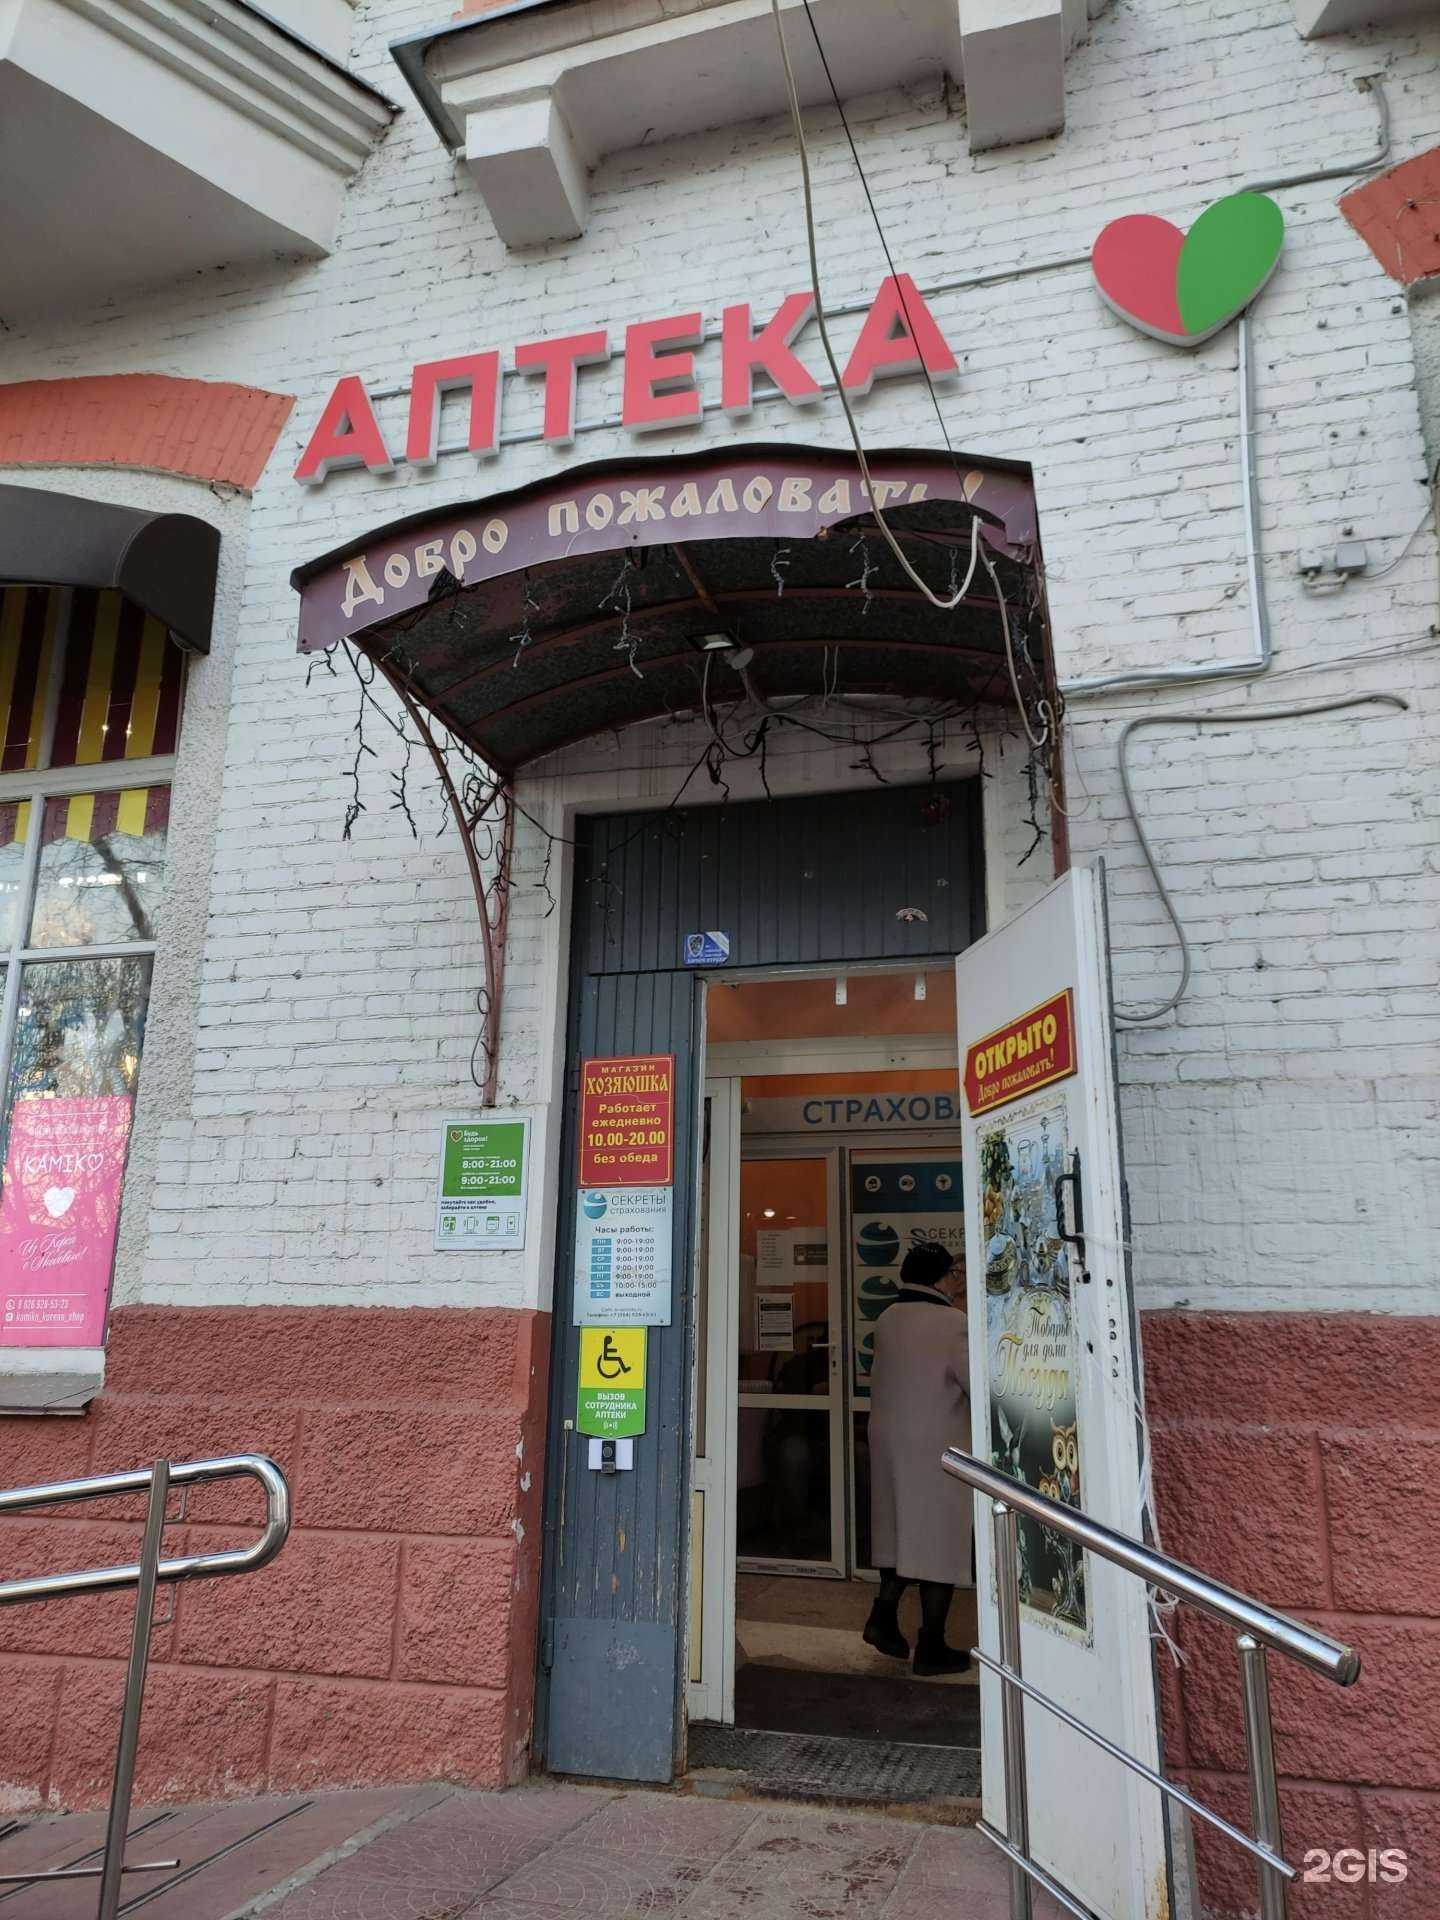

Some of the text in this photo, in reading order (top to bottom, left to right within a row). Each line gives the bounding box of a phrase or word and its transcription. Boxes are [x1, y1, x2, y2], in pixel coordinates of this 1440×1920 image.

[293, 272, 960, 487] АПТЕКА
[975, 1013, 1057, 1080] ОТКРЫТО
[601, 1064, 655, 1073] МАГАЗИН
[586, 1073, 669, 1096] ХОЗЯЮШКА
[599, 1103, 656, 1114] Работает
[802, 1096, 961, 1125] СТРАХОВ
[592, 1117, 661, 1127] ежедневно
[587, 1131, 665, 1147] 10.00-20.00
[593, 1152, 657, 1163] без обеда
[611, 1194, 665, 1206] СЕКРЕТЫ
[609, 1206, 666, 1214] страхования
[619, 1225, 653, 1233] работы:
[584, 1401, 637, 1409] СОТРУДНИКА
